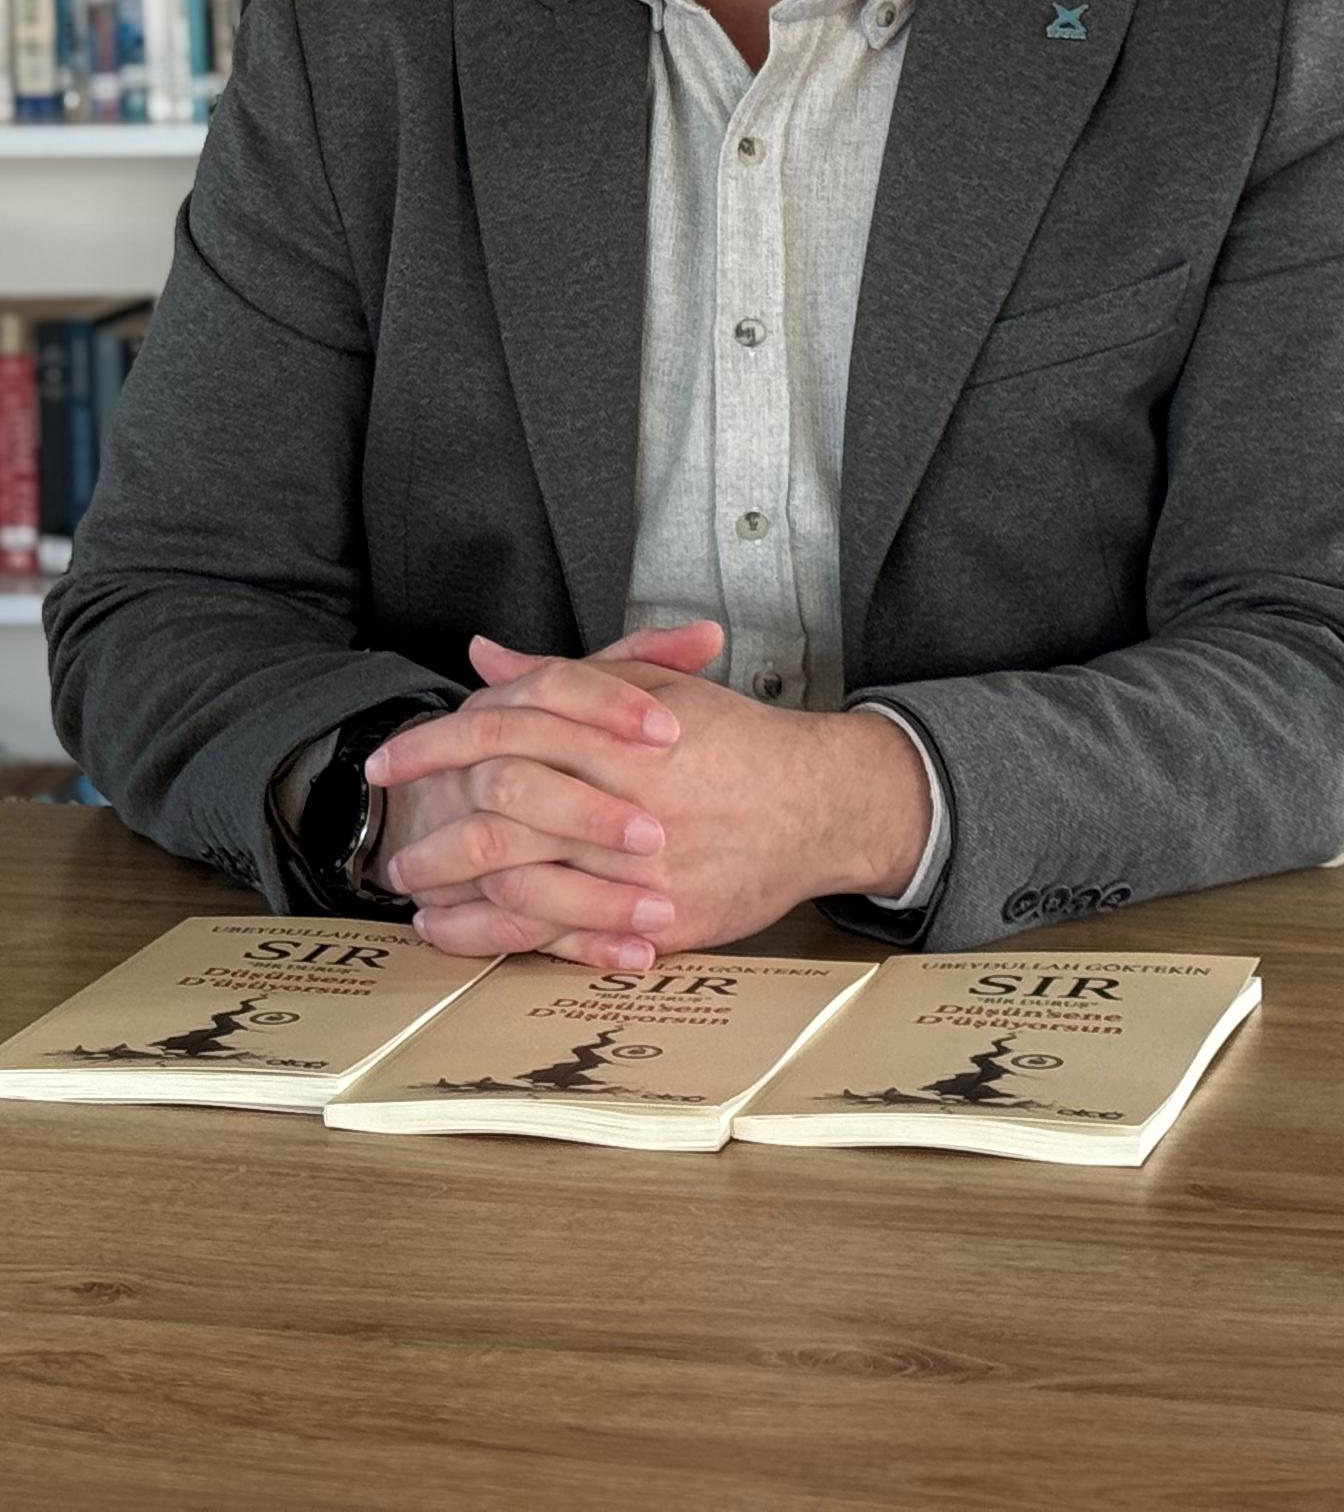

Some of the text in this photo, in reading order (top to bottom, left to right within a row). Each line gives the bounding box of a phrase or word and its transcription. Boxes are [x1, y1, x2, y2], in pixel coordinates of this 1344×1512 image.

[243, 940, 391, 970] SIR
[587, 972, 739, 996] SIR
[968, 973, 1124, 1002] SIR
